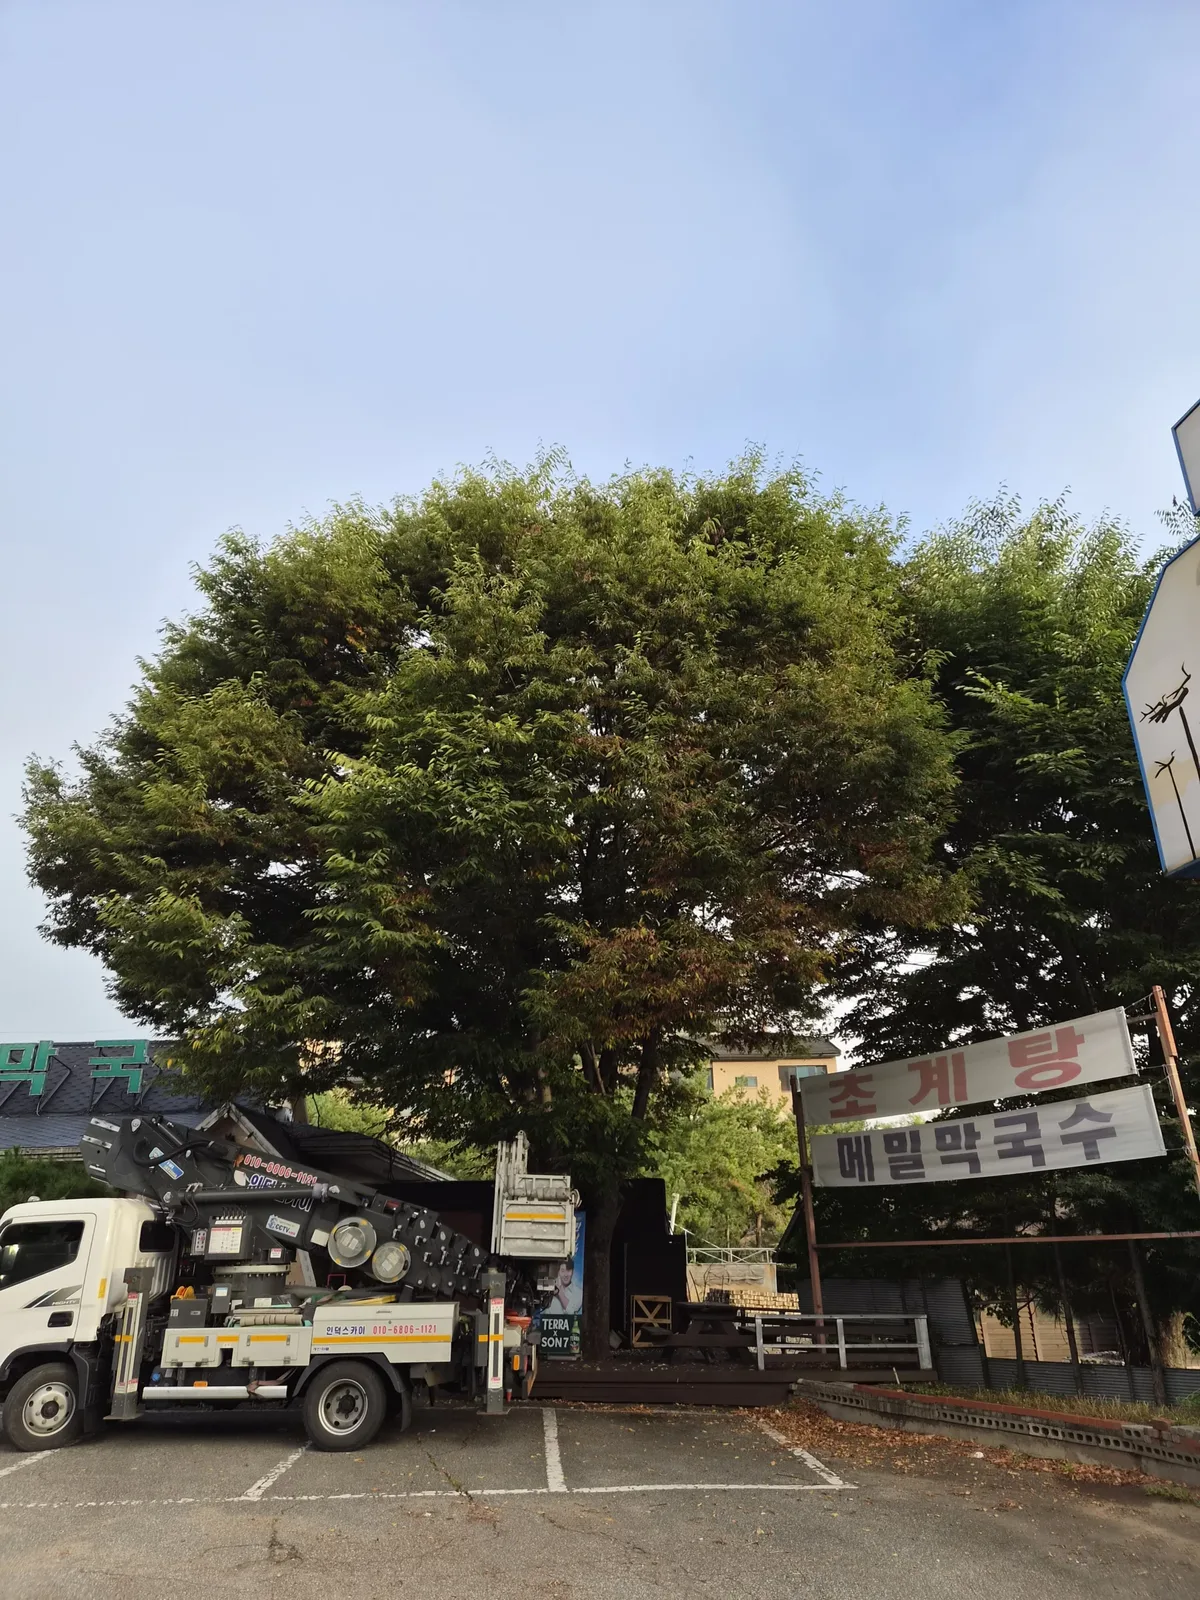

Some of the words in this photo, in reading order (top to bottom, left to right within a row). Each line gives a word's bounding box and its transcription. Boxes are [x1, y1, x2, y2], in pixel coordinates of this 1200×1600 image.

[836, 1102, 1118, 1182] 메밀막국수
[275, 1223, 291, 1233] CCTV
[326, 1326, 366, 1336] 인덕스카이
[372, 1324, 437, 1335] 010-6806-1121
[541, 1318, 570, 1331] TERRA
